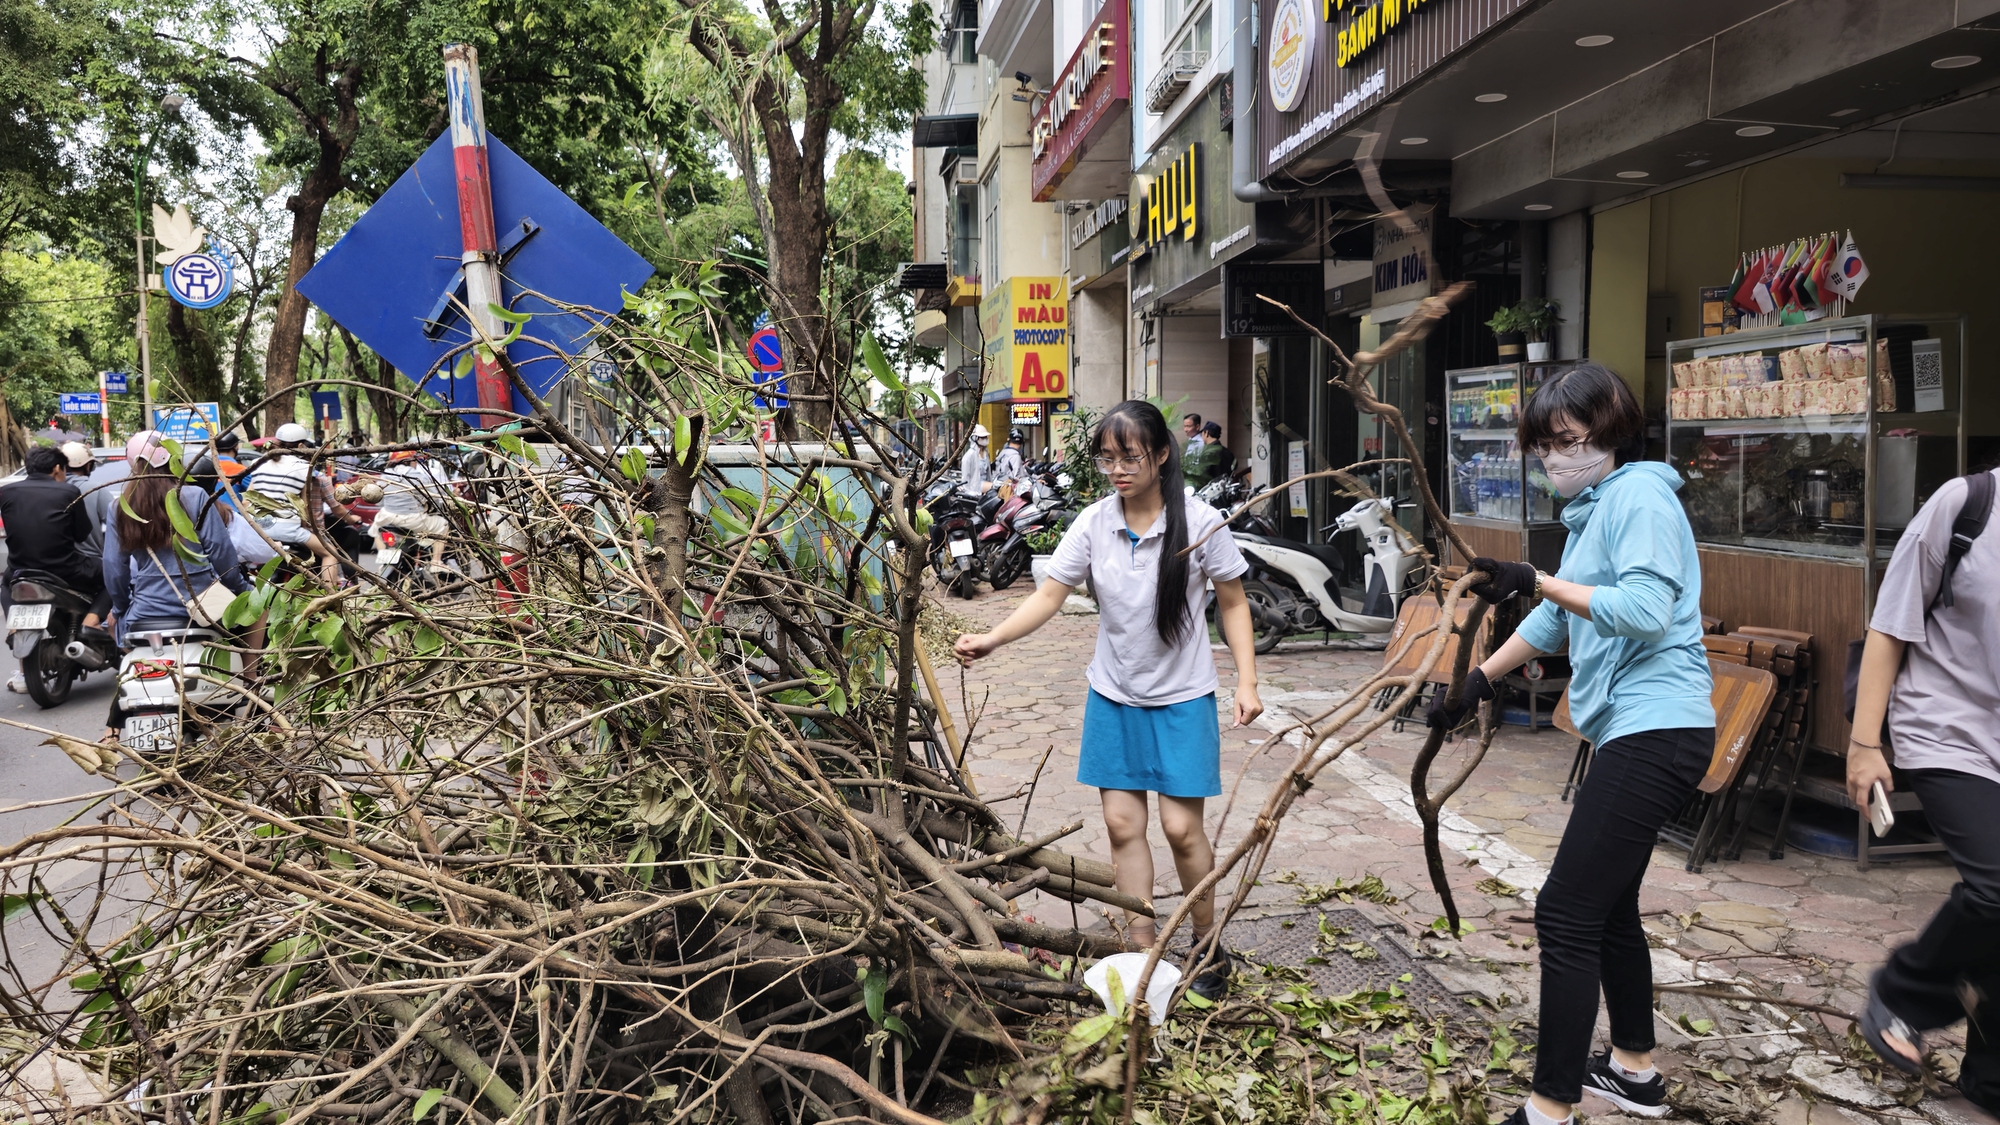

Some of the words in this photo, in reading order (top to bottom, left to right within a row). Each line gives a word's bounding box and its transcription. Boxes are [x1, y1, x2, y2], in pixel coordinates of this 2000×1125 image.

[1337, 3, 1377, 68] BÁNH
[1049, 73, 1074, 136] YOUR
[1073, 22, 1104, 103] HOME
[1375, 258, 1398, 294] KIM
[1029, 283, 1051, 300] IN
[1018, 304, 1064, 323] MÀU
[1013, 328, 1066, 345] PHOTOCOPY
[1251, 325, 1271, 333] PHAN
[64, 401, 79, 411] HÒE
[80, 402, 98, 411] NHAI
[15, 606, 44, 617] 30-H2
[13, 617, 42, 628] 6308
